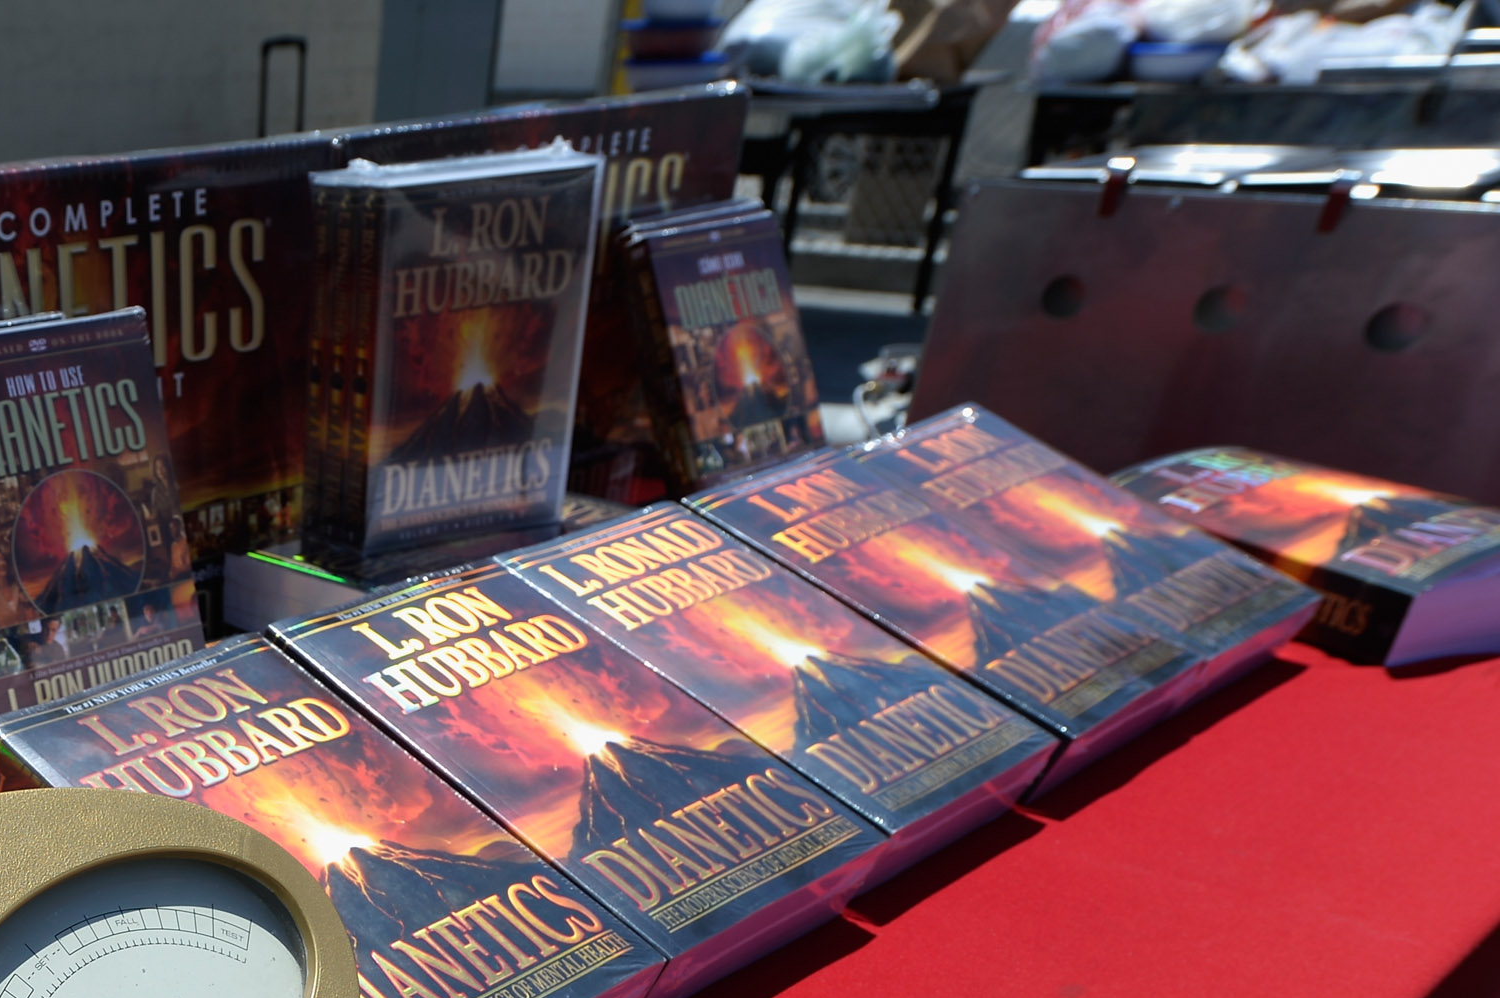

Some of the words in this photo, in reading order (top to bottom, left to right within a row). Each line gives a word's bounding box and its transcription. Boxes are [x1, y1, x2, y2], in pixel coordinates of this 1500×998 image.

[432, 209, 460, 257] L.
[470, 196, 550, 251] RON
[393, 250, 574, 318] HUBBARD
[71, 332, 92, 345] THE
[5, 375, 37, 398] HOW
[39, 370, 57, 391] TO
[59, 364, 86, 388] USE
[381, 437, 553, 516] DIANETICS
[774, 468, 868, 515] RON
[748, 495, 802, 524] L.
[771, 489, 931, 564] HUBBARD
[538, 563, 602, 598] L.
[570, 519, 724, 588] RONALD
[586, 548, 773, 632] HUBBARD
[352, 622, 425, 661] L.
[392, 586, 514, 647] RON
[63, 704, 83, 715] The
[83, 700, 94, 710] #1
[92, 690, 119, 705] NEW
[119, 680, 150, 697] YORK
[147, 669, 182, 687] TIMES
[179, 657, 218, 676] Bestseller
[361, 614, 588, 715] HUBBARD
[78, 714, 158, 758] L.
[120, 667, 270, 740] RON
[581, 767, 835, 912] DIANETICS
[653, 907, 687, 930] THE
[683, 882, 729, 918] MODERN
[721, 865, 771, 893] SCIENCE
[766, 859, 784, 874] OF
[777, 838, 818, 868] MENTAL
[811, 818, 860, 848] HEALTH
[114, 917, 138, 928] FALL
[220, 927, 244, 943] TEST
[34, 954, 51, 972] SET
[531, 952, 587, 992] MENTAL
[573, 931, 630, 969] HEALTH
